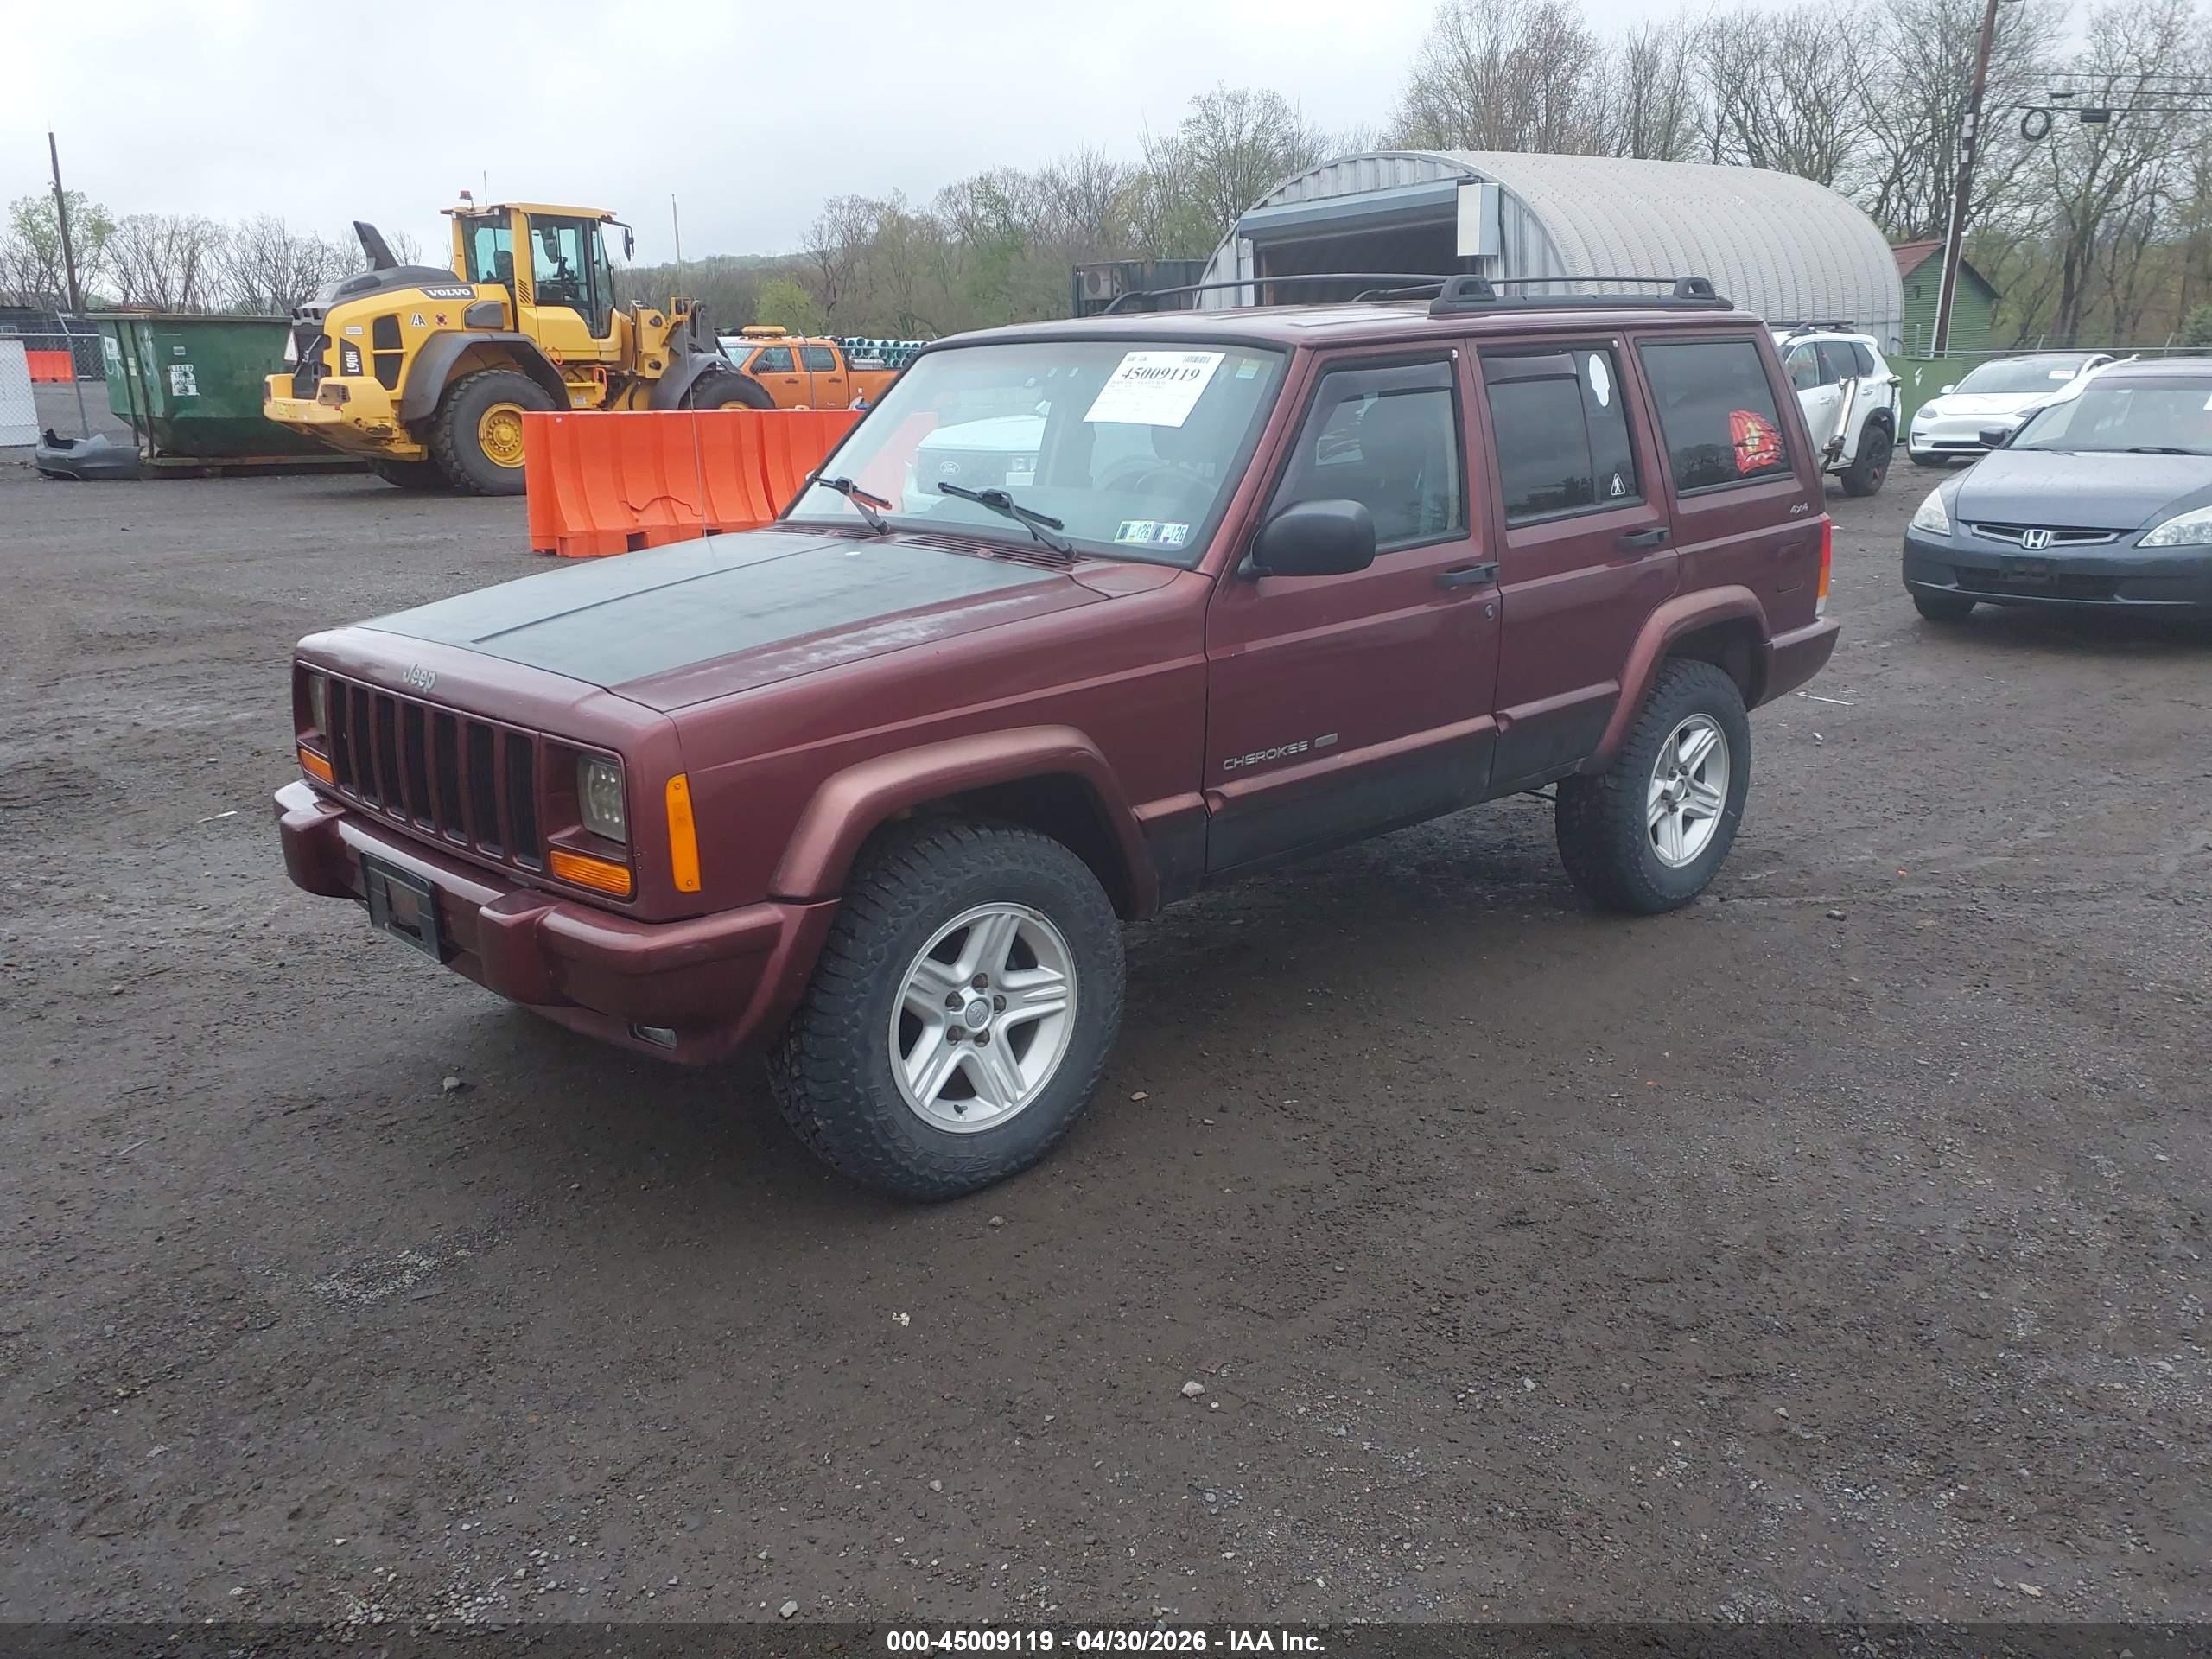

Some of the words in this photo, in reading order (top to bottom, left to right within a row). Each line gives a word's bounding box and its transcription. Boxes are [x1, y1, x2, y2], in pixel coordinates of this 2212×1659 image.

[427, 288, 471, 296] VOLVO
[346, 351, 360, 373] L90H
[1122, 366, 1201, 381] 45009119
[403, 664, 436, 694] Jeep
[1223, 741, 1309, 771] CHEROKEE
